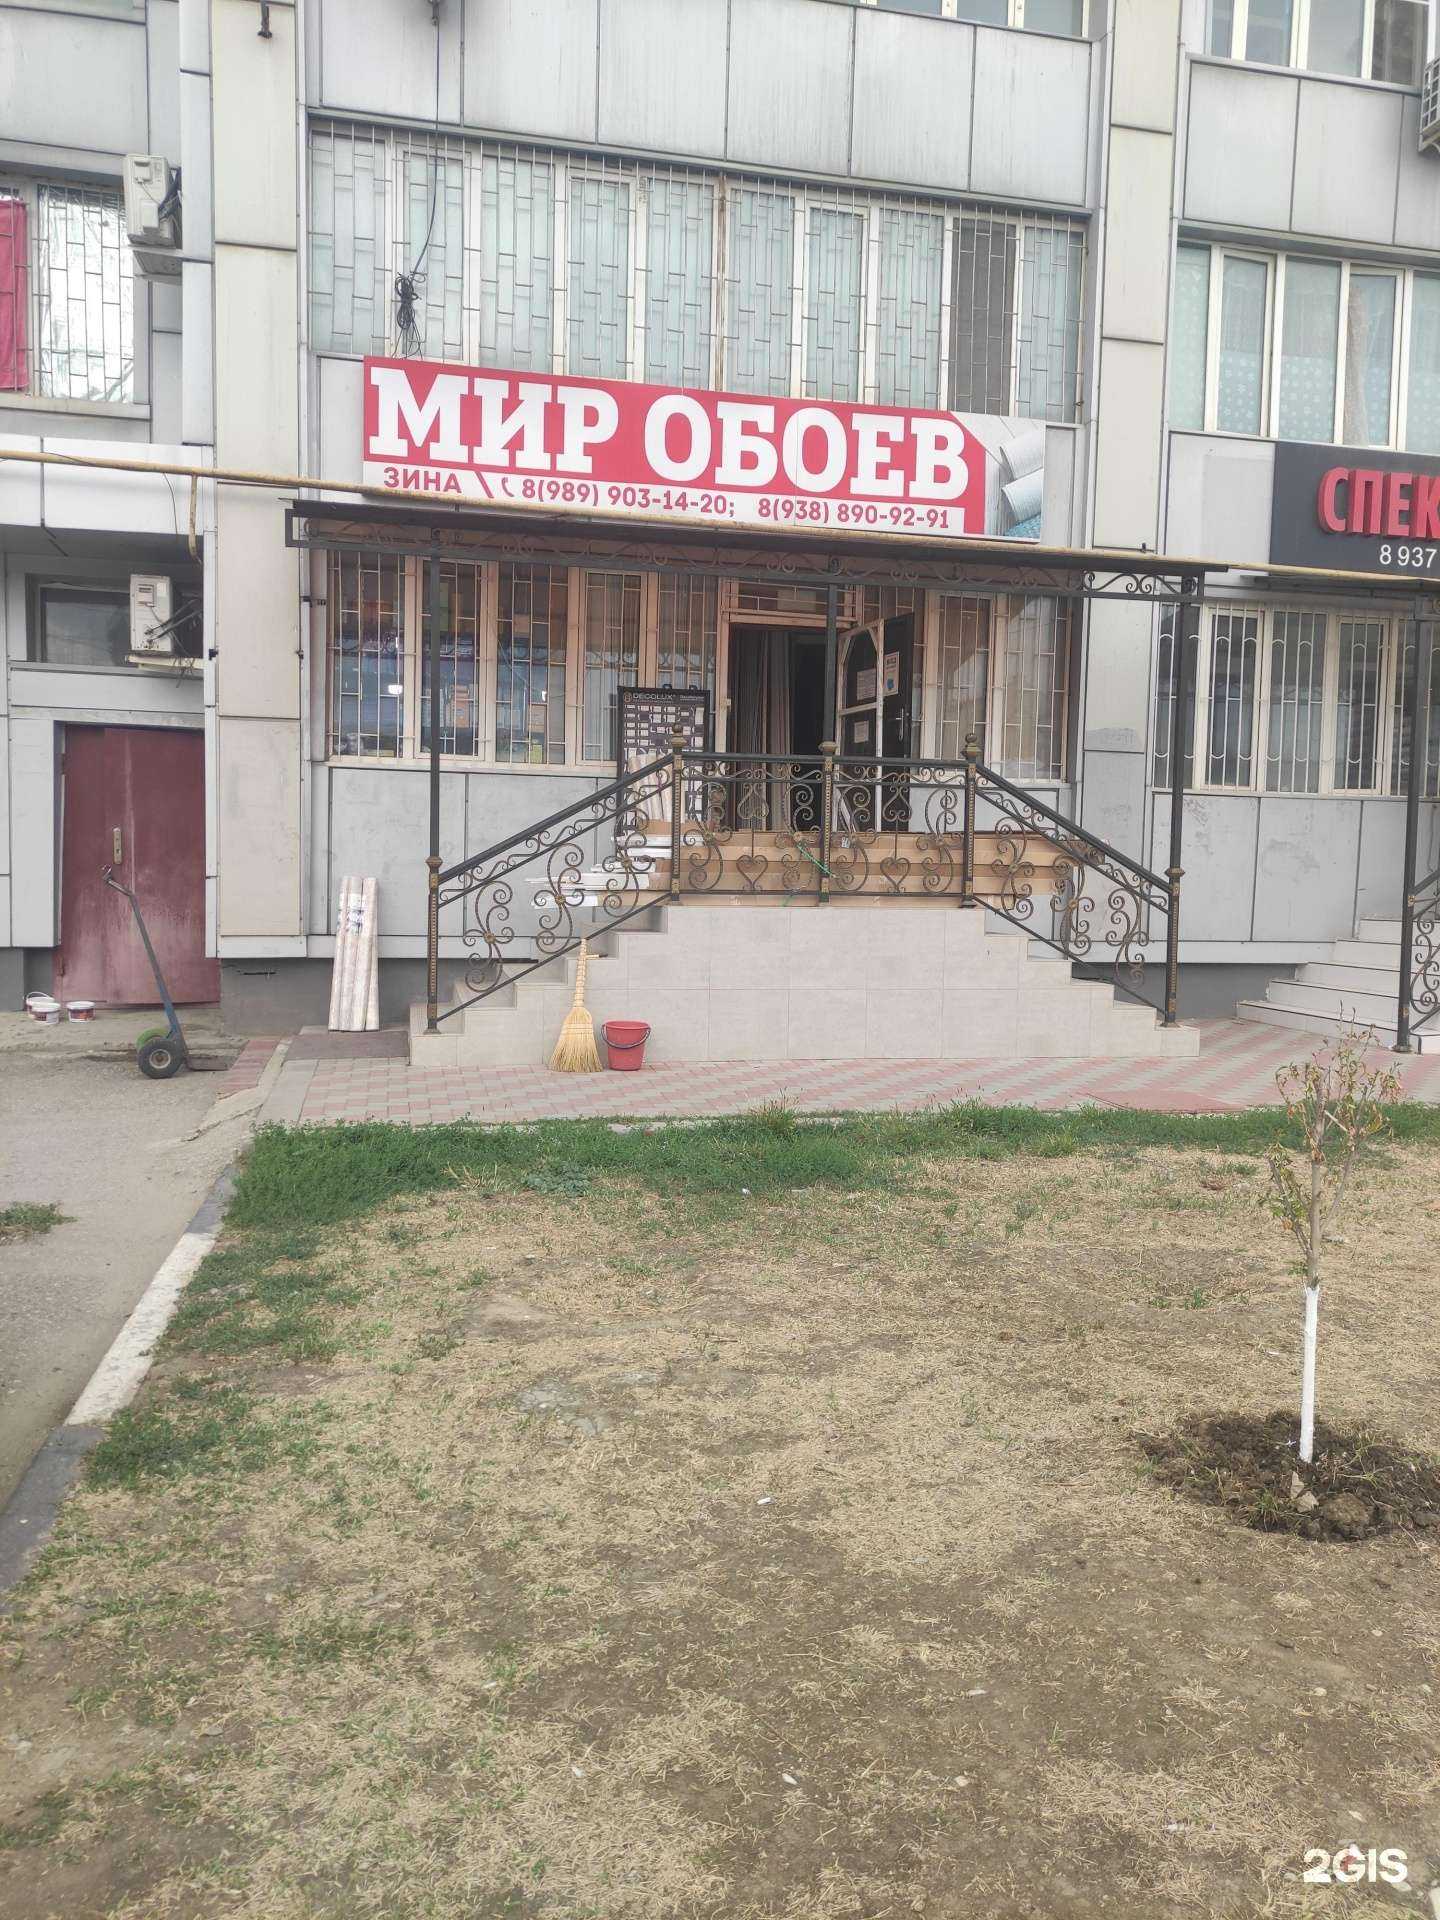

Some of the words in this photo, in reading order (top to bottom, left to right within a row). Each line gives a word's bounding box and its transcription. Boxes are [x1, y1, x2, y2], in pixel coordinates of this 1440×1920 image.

[369, 366, 619, 474] МИР
[644, 394, 969, 500] ОБОЕВ
[383, 466, 463, 494] ЗИНА
[521, 479, 600, 506] 8(989)
[607, 486, 736, 518] 903-14-20;
[758, 498, 829, 523] 8(938)
[837, 502, 950, 529] 890-92-91
[1397, 545, 1437, 569] 937
